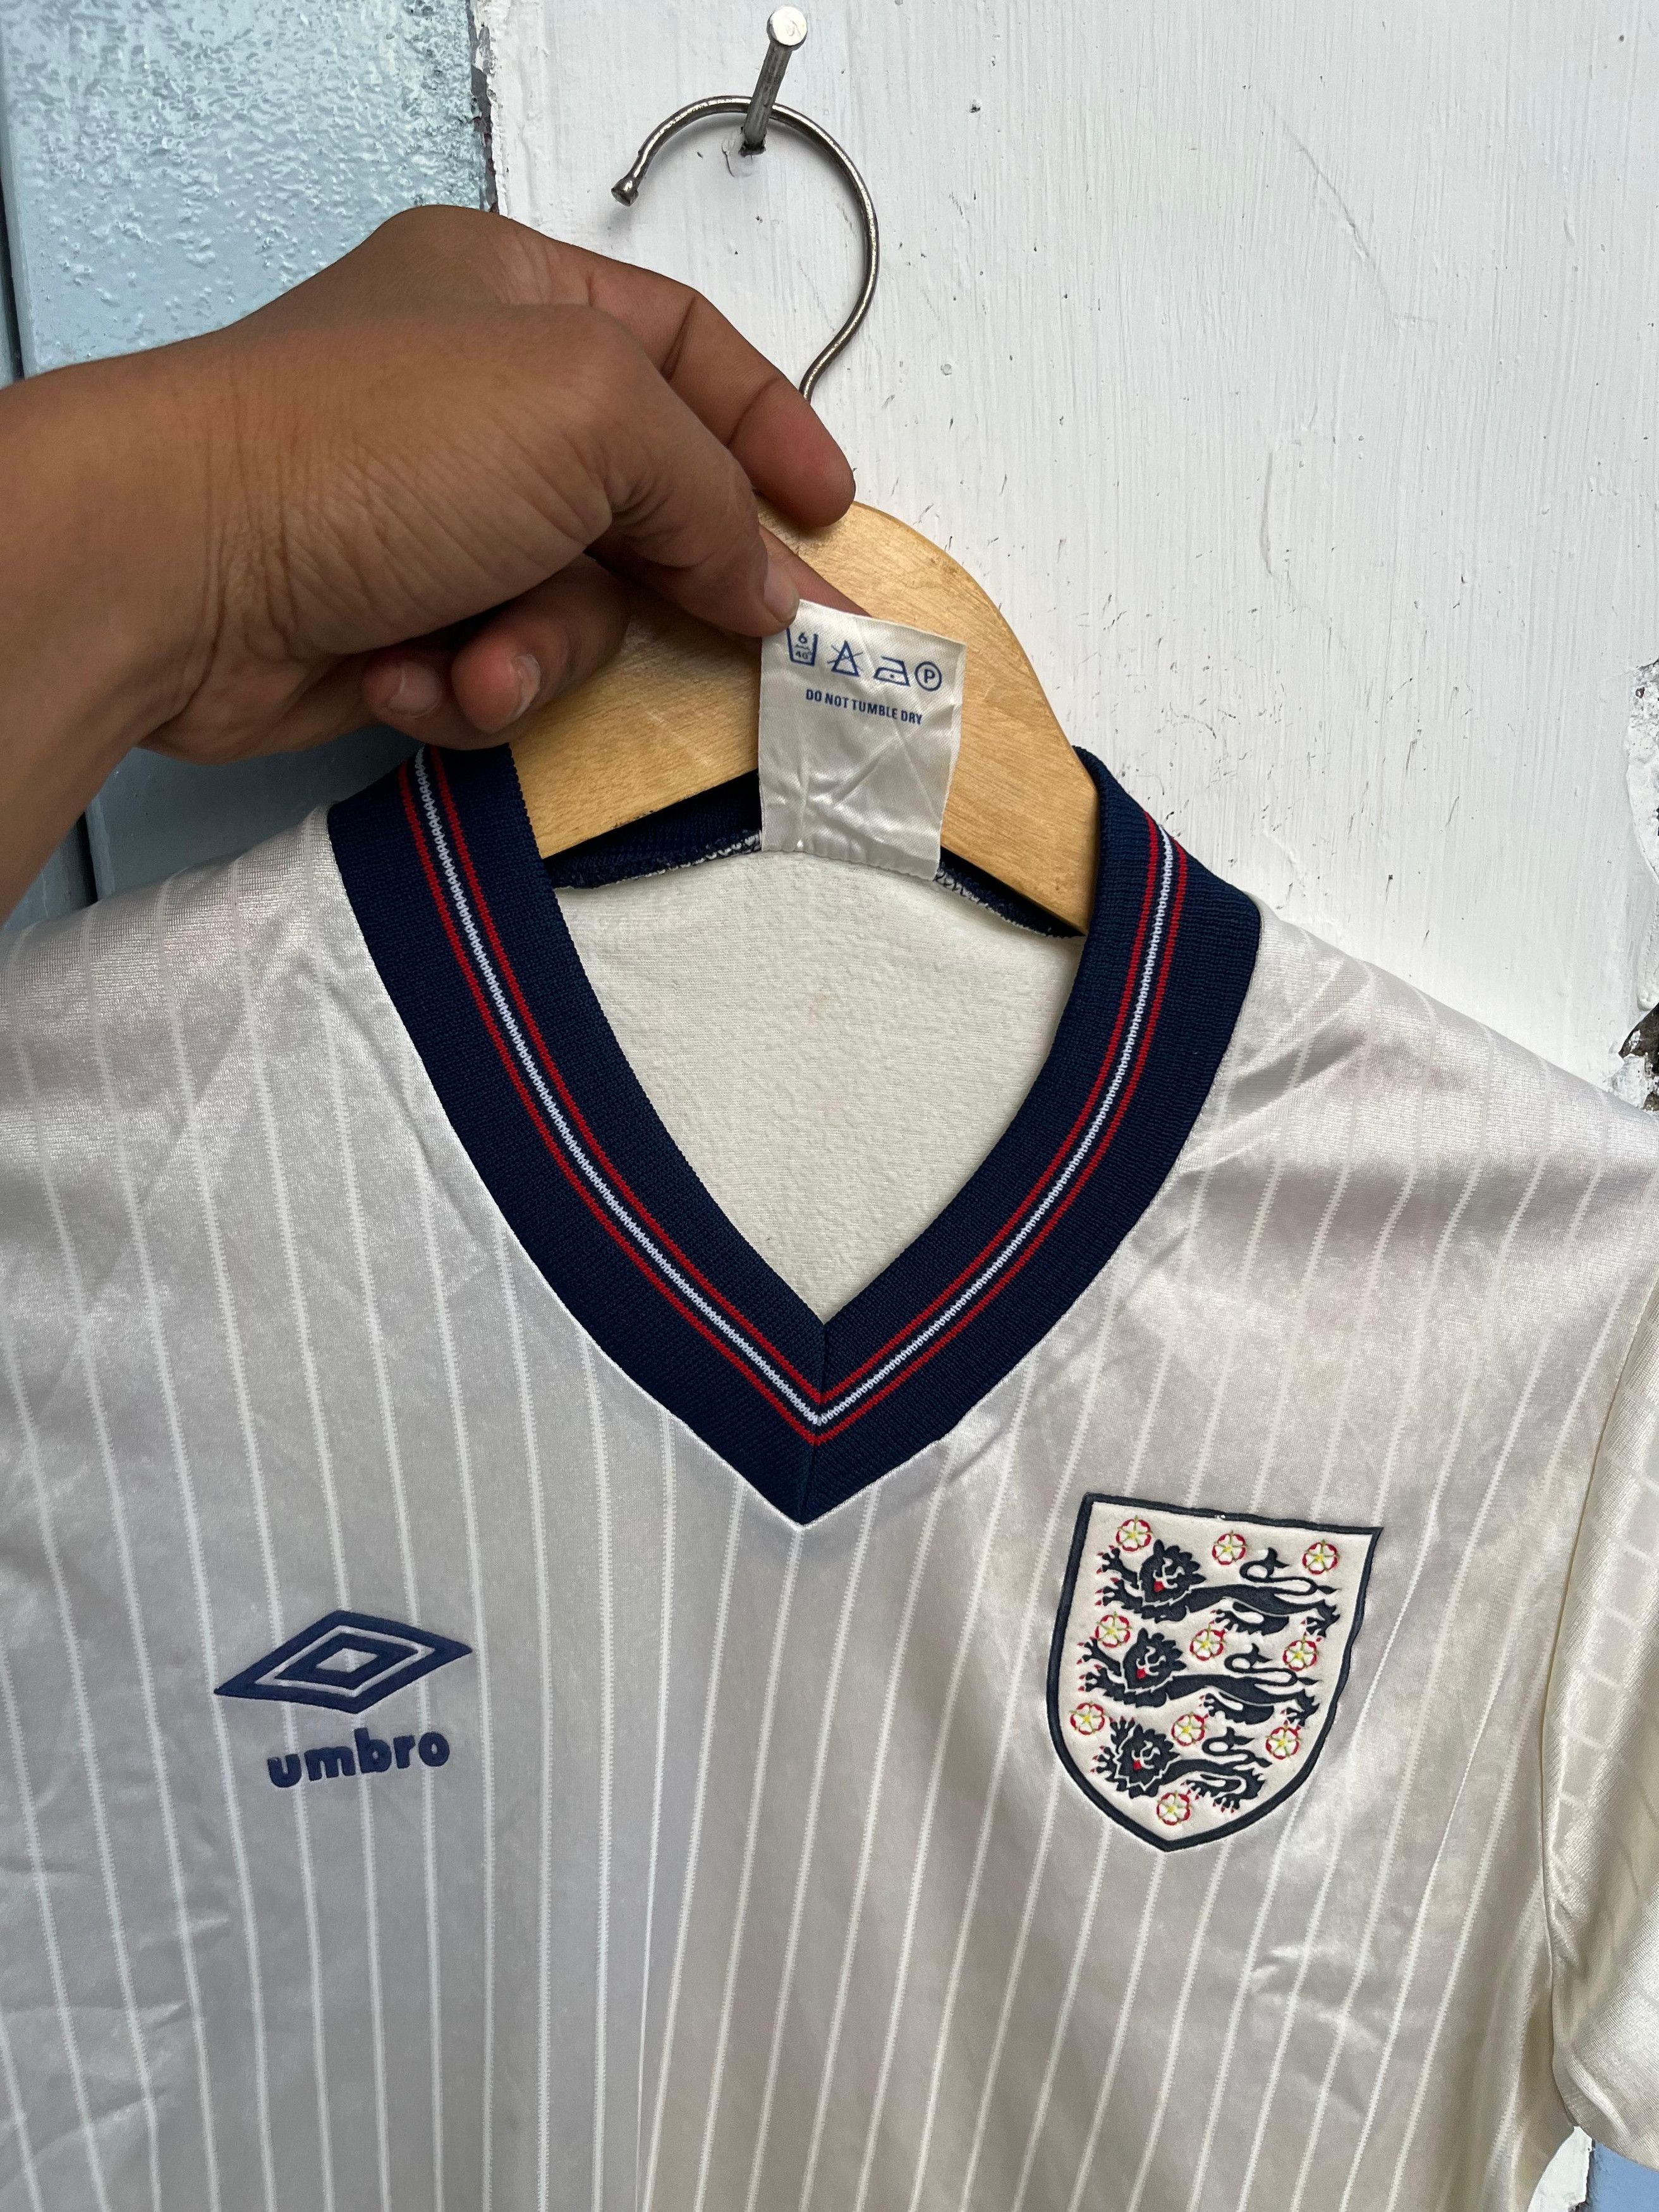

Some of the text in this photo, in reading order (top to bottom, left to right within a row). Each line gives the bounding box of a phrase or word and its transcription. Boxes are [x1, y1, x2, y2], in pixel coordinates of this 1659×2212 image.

[798, 632, 808, 643] 6
[923, 669, 935, 683] P
[806, 688, 923, 725] DO NOT TUMBLE DRY
[267, 1727, 449, 1788] umbro
